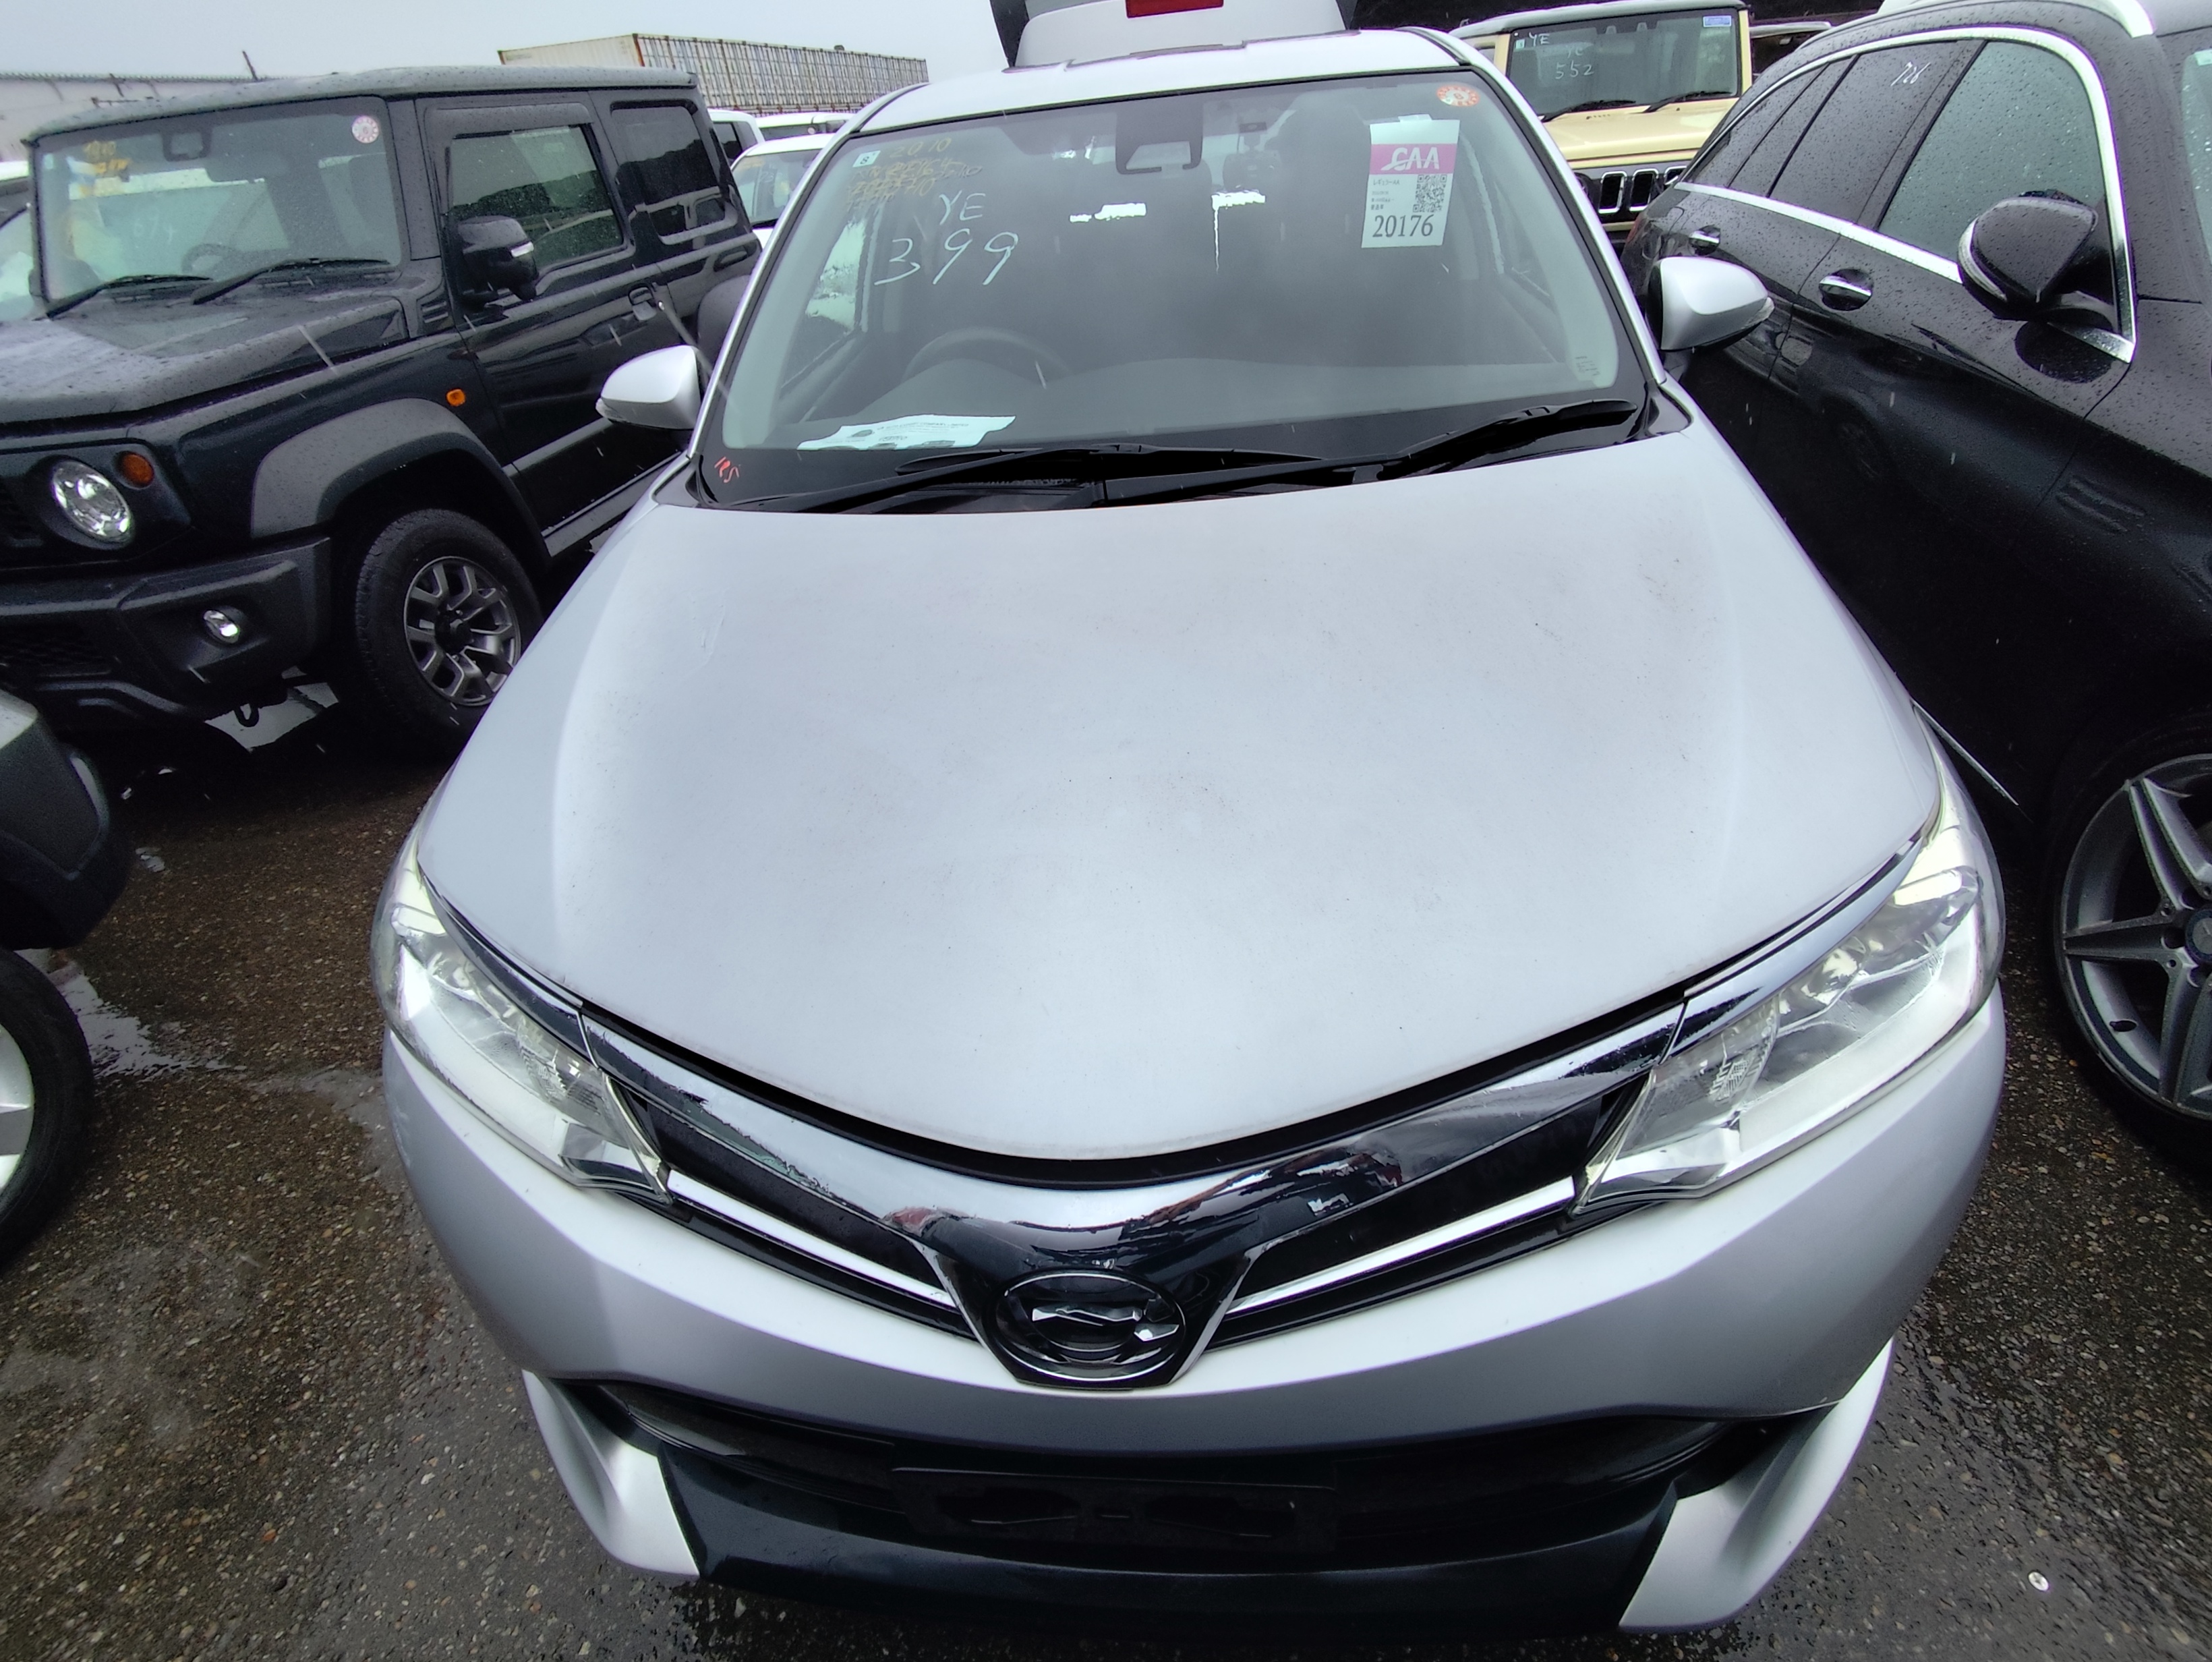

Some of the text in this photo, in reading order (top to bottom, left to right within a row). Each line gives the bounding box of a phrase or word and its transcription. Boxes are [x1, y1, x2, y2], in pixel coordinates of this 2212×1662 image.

[1555, 60, 1594, 80] 552
[1380, 146, 1440, 171] CAA
[939, 190, 986, 226] YE
[1372, 214, 1435, 238] 20176
[874, 228, 1018, 285] 399
